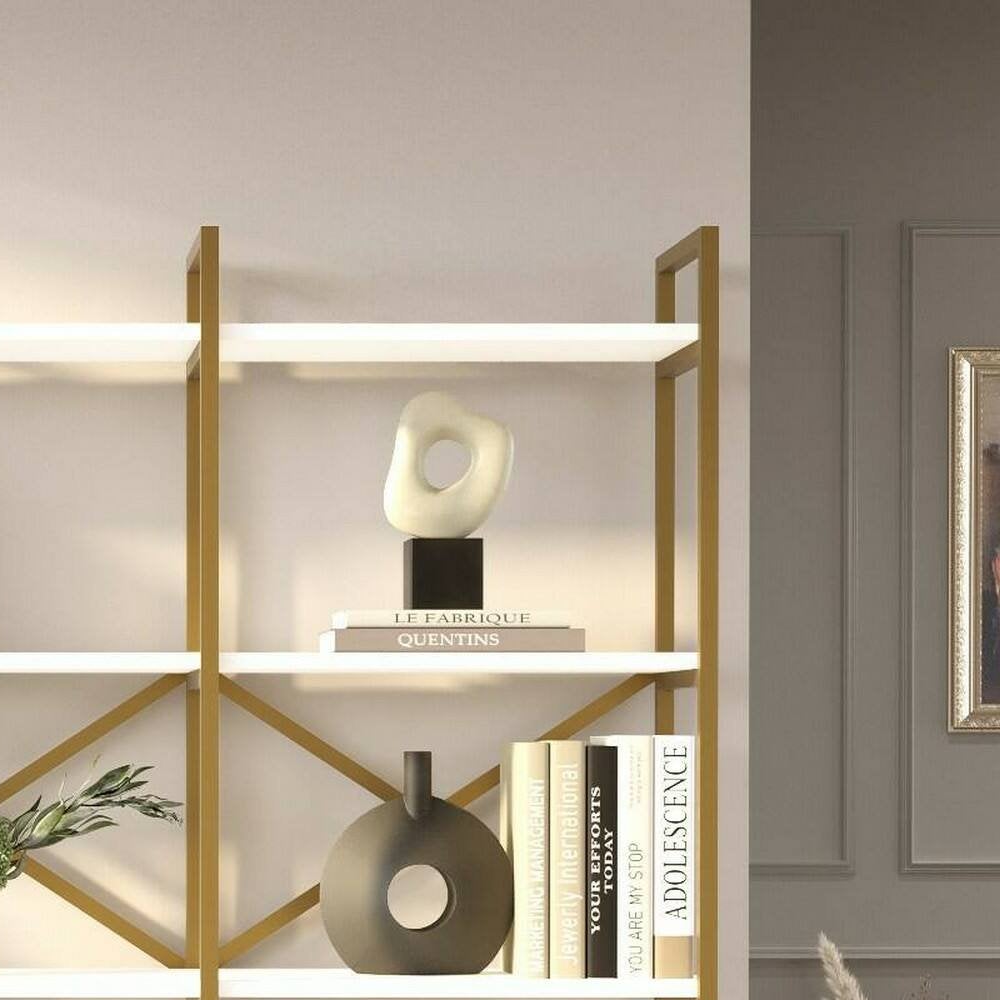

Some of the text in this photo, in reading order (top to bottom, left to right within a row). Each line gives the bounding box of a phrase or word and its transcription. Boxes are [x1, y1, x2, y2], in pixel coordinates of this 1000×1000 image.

[395, 612, 532, 626] LE FABRIQUE
[397, 632, 500, 648] QUENTINS
[558, 762, 580, 885] International
[590, 786, 601, 935] YOUR EFFORTS
[603, 827, 614, 894] TODAY
[663, 745, 687, 920] ADOLESCENCE
[628, 842, 644, 974] YOU ARE MY STOP
